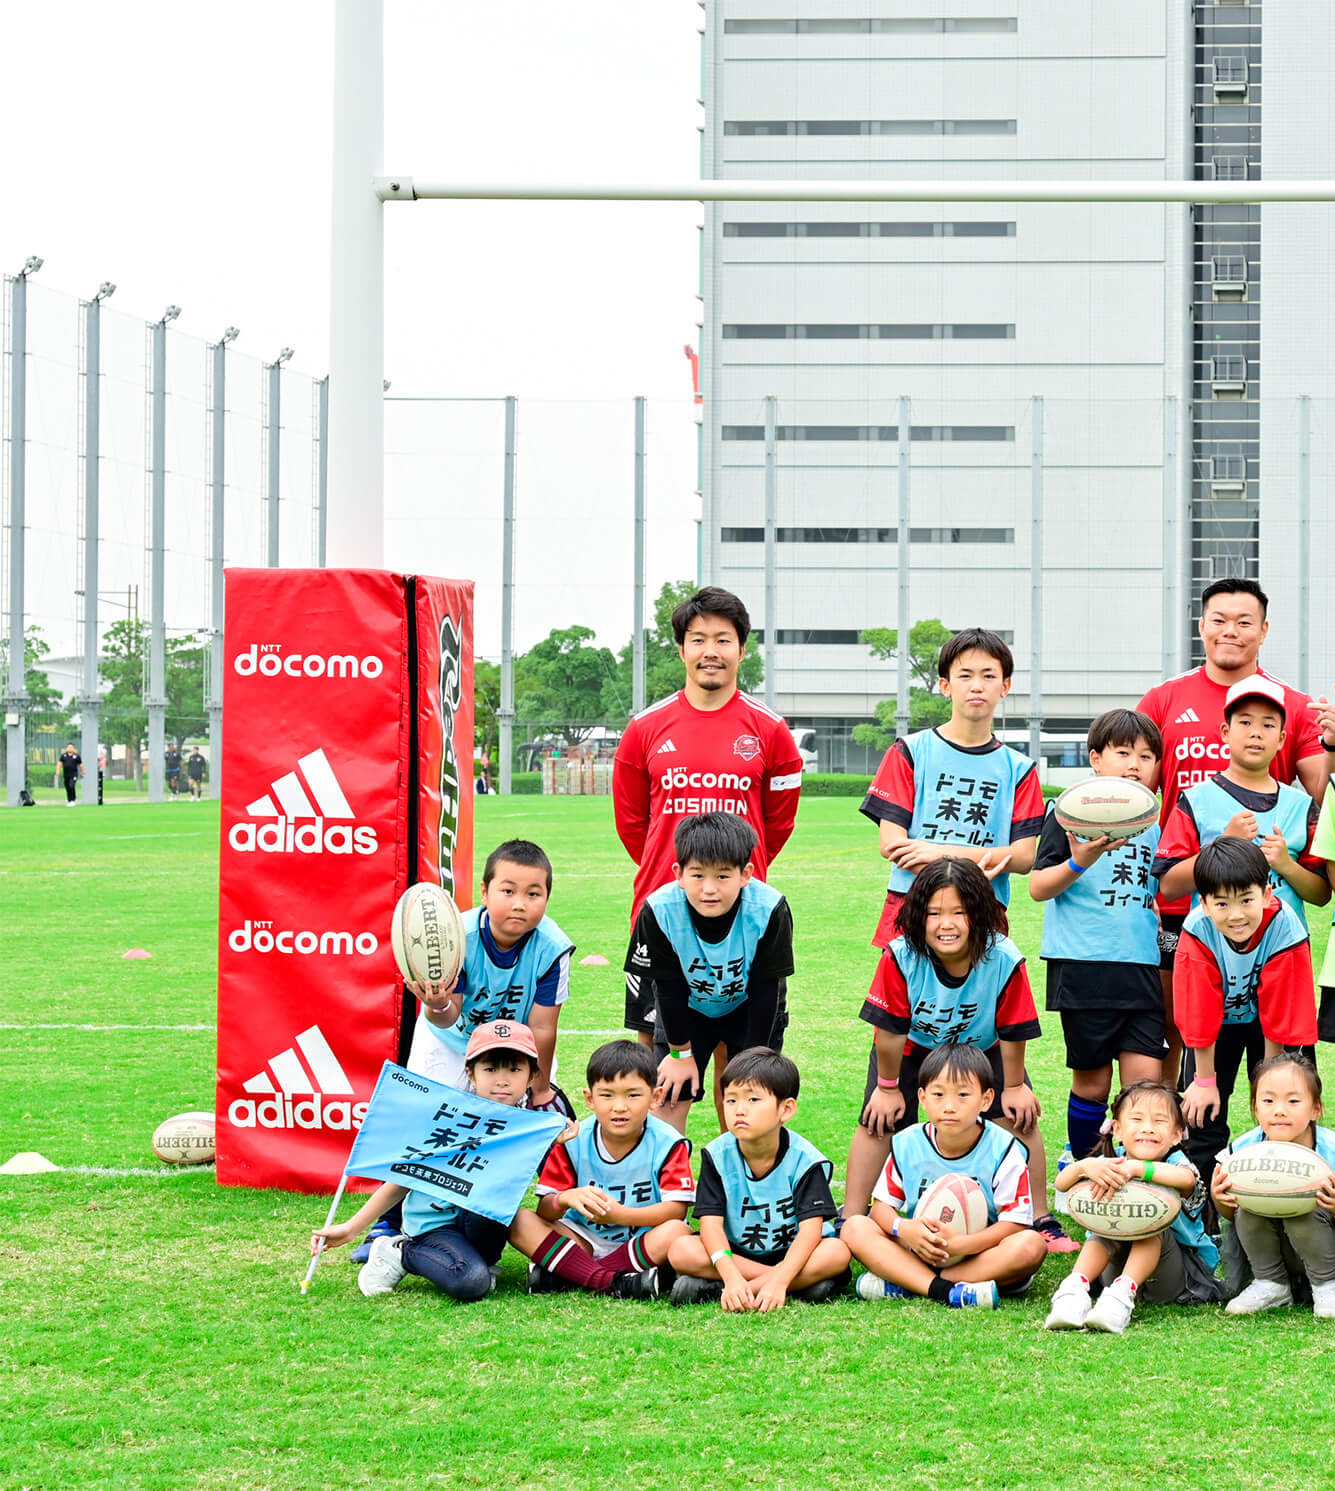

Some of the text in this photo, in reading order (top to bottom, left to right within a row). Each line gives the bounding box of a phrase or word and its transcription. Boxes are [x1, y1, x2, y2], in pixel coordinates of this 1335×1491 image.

[260, 644, 282, 652] NTT
[234, 644, 384, 678] docomo
[661, 768, 751, 791] docomo
[936, 773, 998, 800] ドコモ
[935, 797, 989, 826] 未来
[228, 815, 379, 854] adidas
[922, 824, 995, 847] フィールド
[228, 920, 378, 955] docomo
[421, 899, 442, 980] GILBERT
[914, 1001, 978, 1023] ドコモ
[391, 1072, 430, 1094] docomo
[432, 1103, 507, 1136] ドコモ
[1228, 1158, 1315, 1177] GILBERT
[1075, 1200, 1158, 1218] GILBERT
[739, 1224, 797, 1249] 未来
